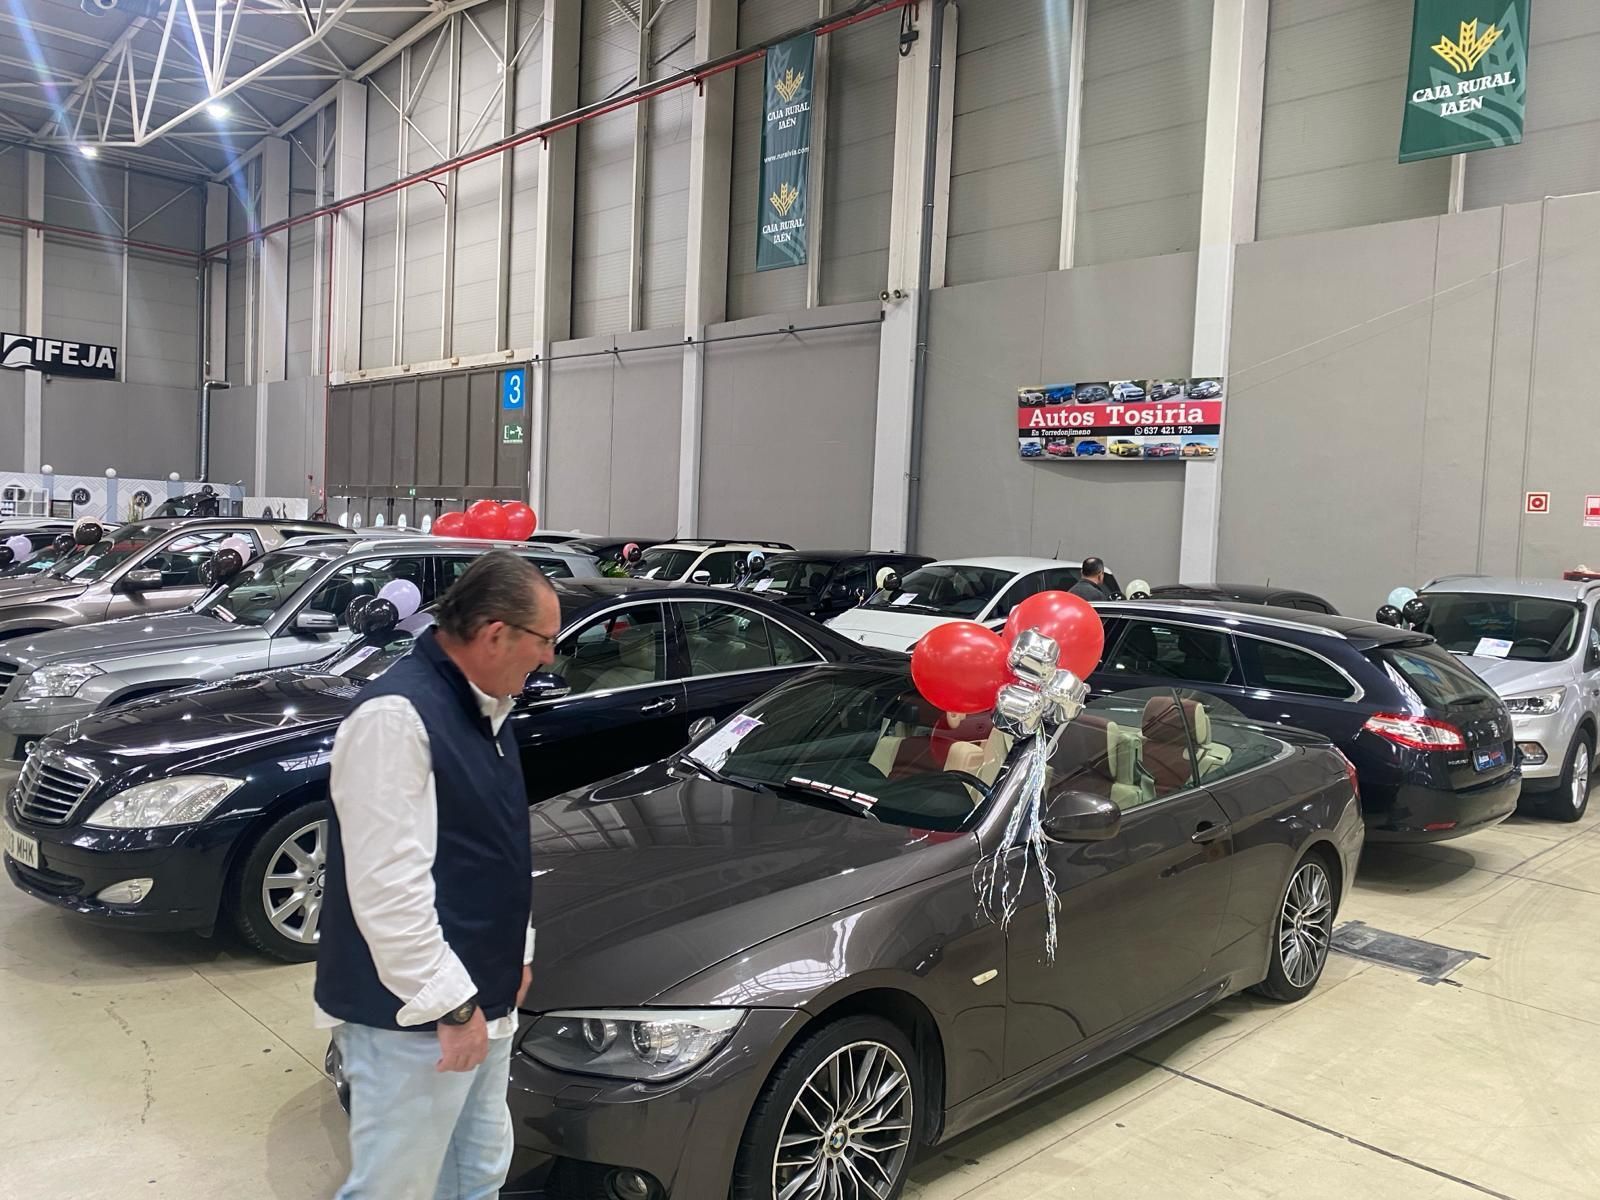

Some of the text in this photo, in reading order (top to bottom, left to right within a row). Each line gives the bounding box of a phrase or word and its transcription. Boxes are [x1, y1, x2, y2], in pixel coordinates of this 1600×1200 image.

[1412, 71, 1516, 103] CAJA RURAL
[767, 102, 810, 122] CAJA RURAL
[1440, 95, 1484, 117] JAÉN
[762, 218, 805, 235] CAJA RURAL
[35, 338, 115, 369] IFEJA
[509, 374, 521, 404] 3
[1029, 403, 1204, 427] Autos Tosiria
[1042, 429, 1091, 437] Torredonjimeno
[1143, 426, 1159, 435] 637
[1160, 426, 1175, 435] 421
[1178, 425, 1193, 434] 752
